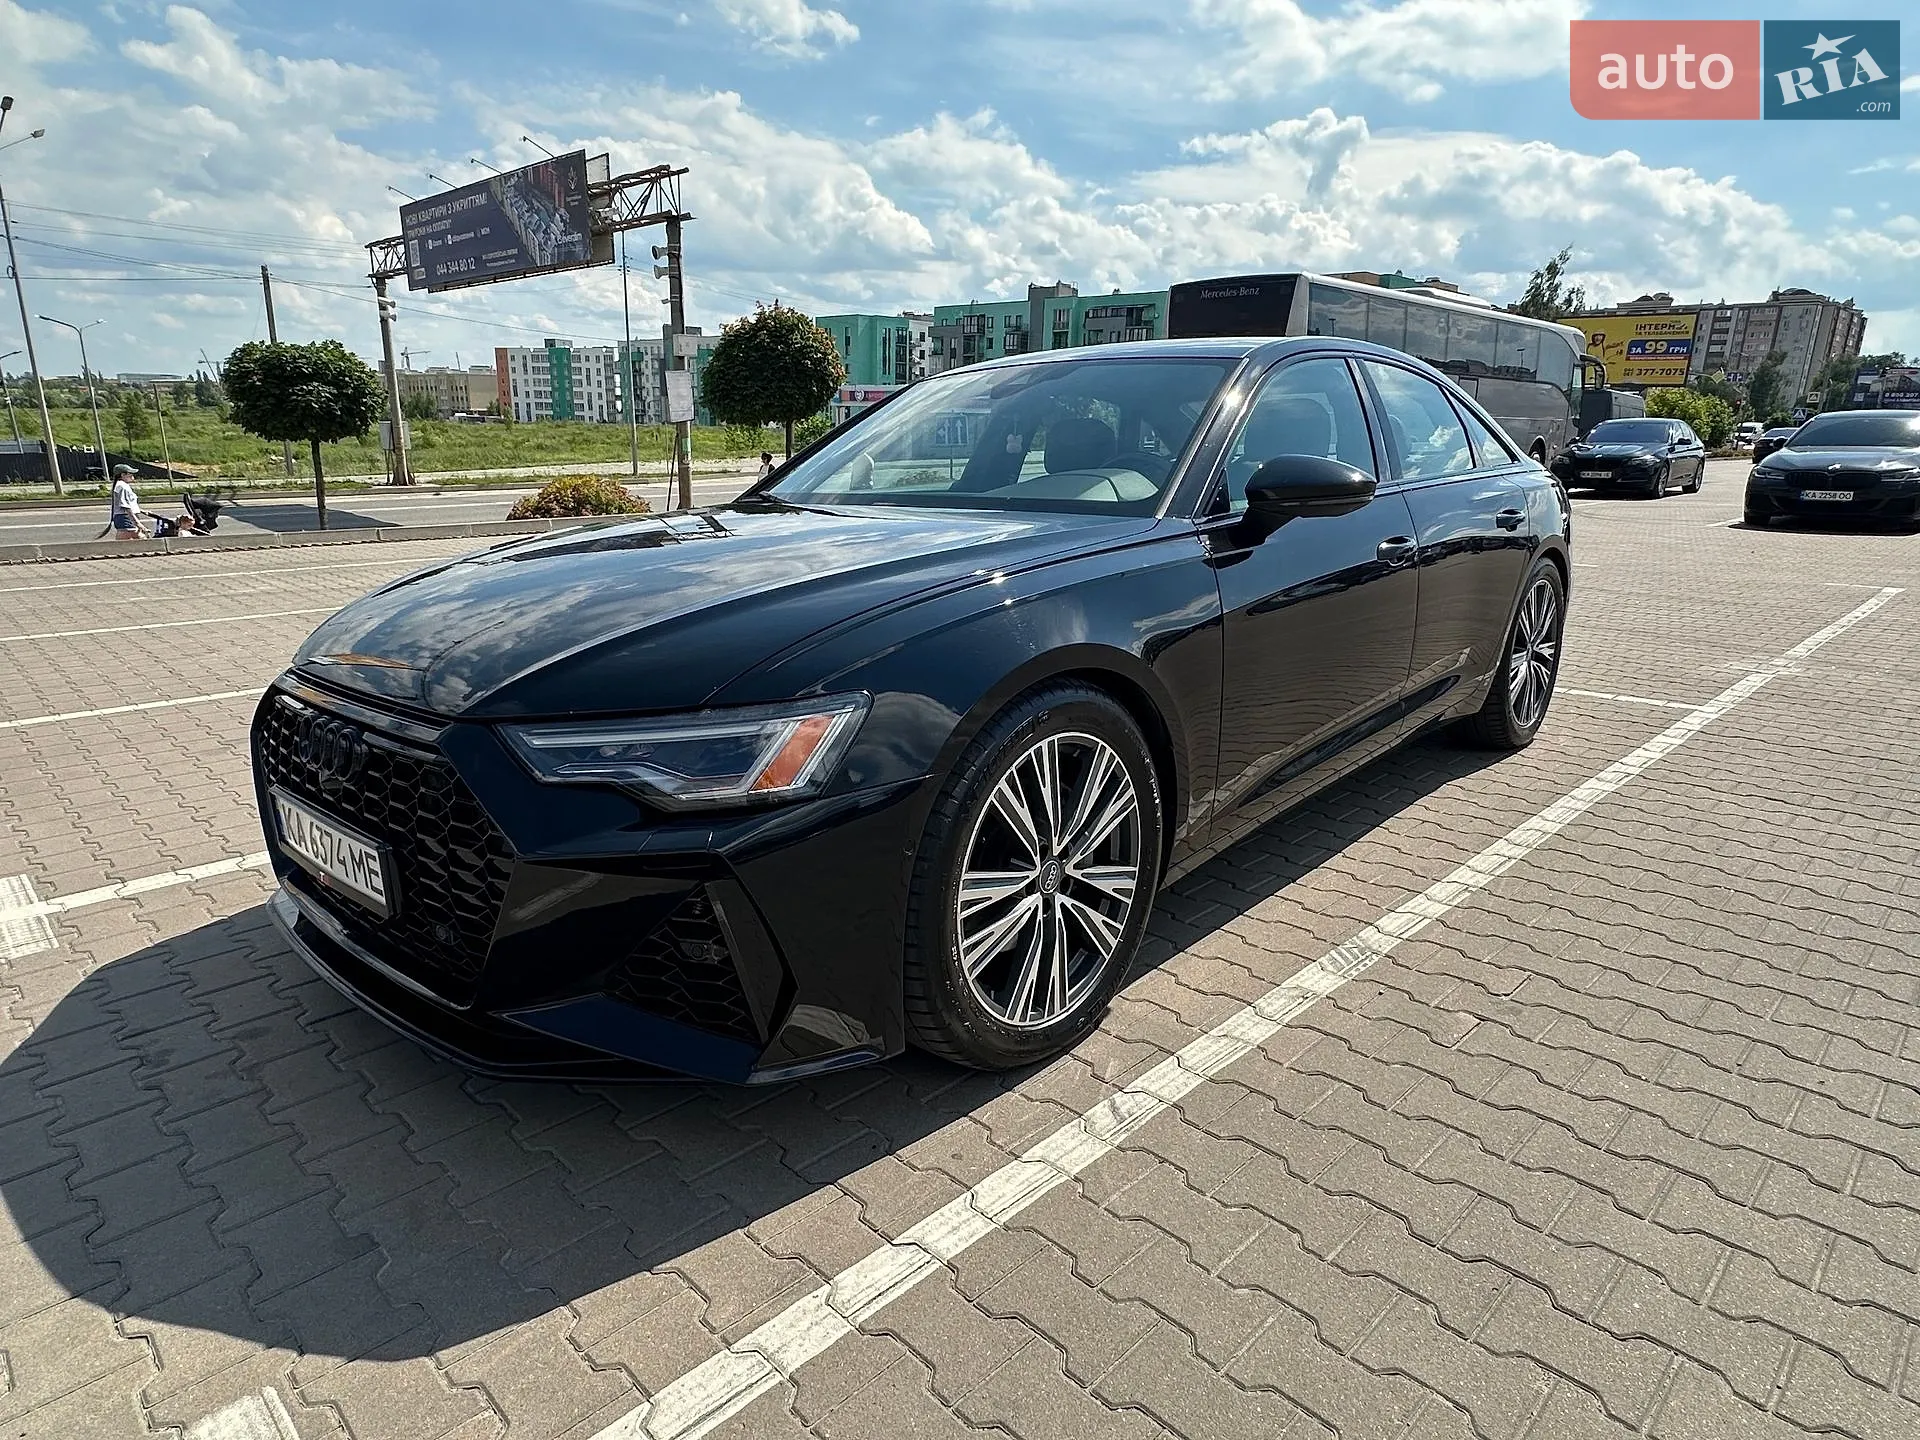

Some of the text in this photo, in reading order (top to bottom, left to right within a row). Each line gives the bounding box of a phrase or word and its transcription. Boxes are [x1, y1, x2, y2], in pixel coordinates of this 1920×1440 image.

[436, 263, 448, 275] 044
[448, 260, 459, 274] 344
[459, 258, 468, 272] 80
[468, 257, 476, 270] 12
[1200, 286, 1260, 299] Mercedes-Benz
[1644, 340, 1668, 354] 99
[1636, 367, 1685, 376] 377-7075
[1805, 491, 1817, 499] KA
[281, 803, 384, 897] KA 6374 ME
